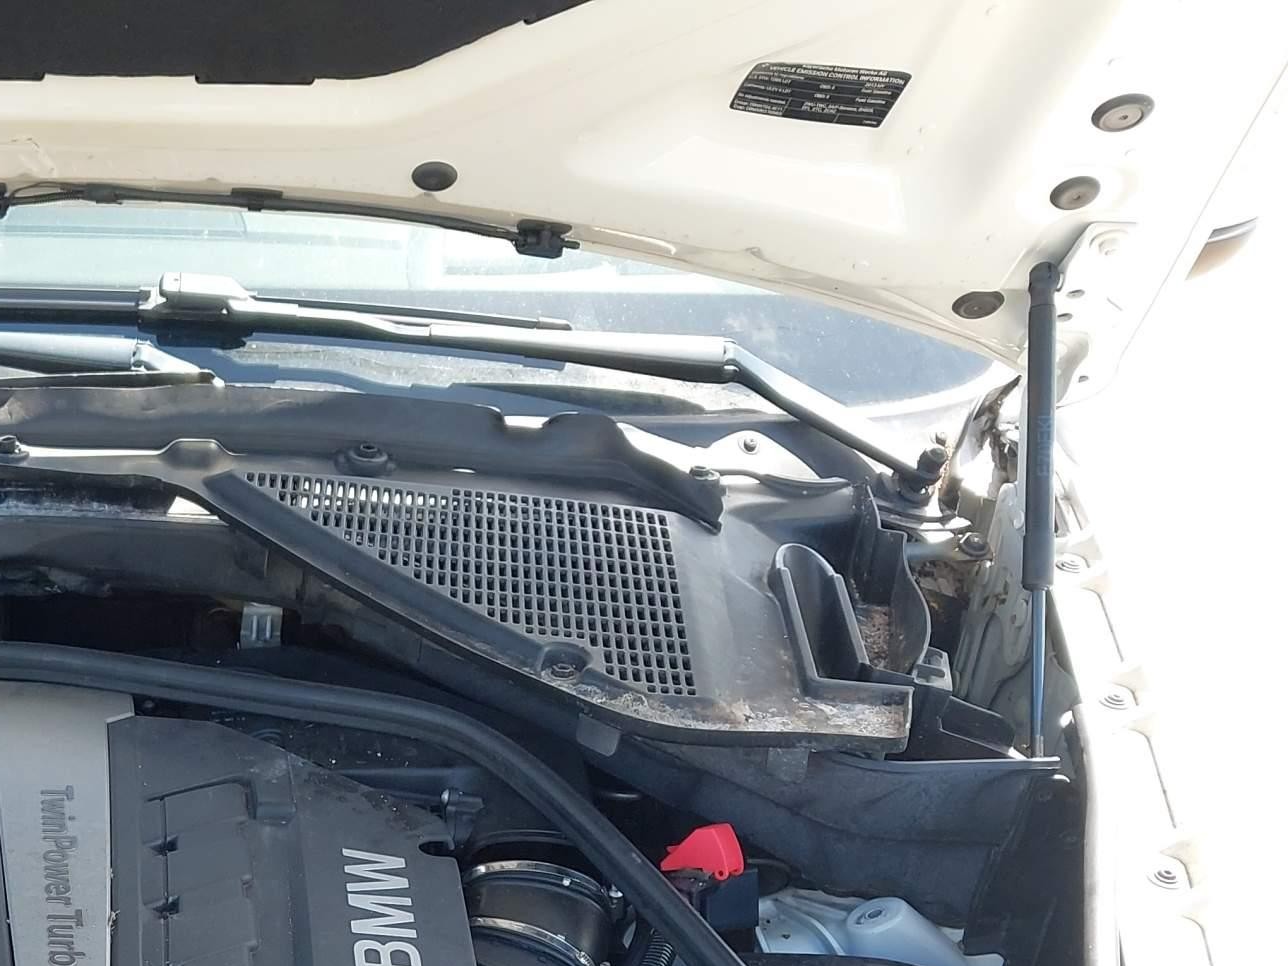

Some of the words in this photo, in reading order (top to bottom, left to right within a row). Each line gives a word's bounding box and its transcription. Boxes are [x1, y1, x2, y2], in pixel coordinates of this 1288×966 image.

[795, 68, 828, 78] EMISSION
[859, 75, 905, 85] INFORMATION
[39, 784, 79, 905] TwinPower
